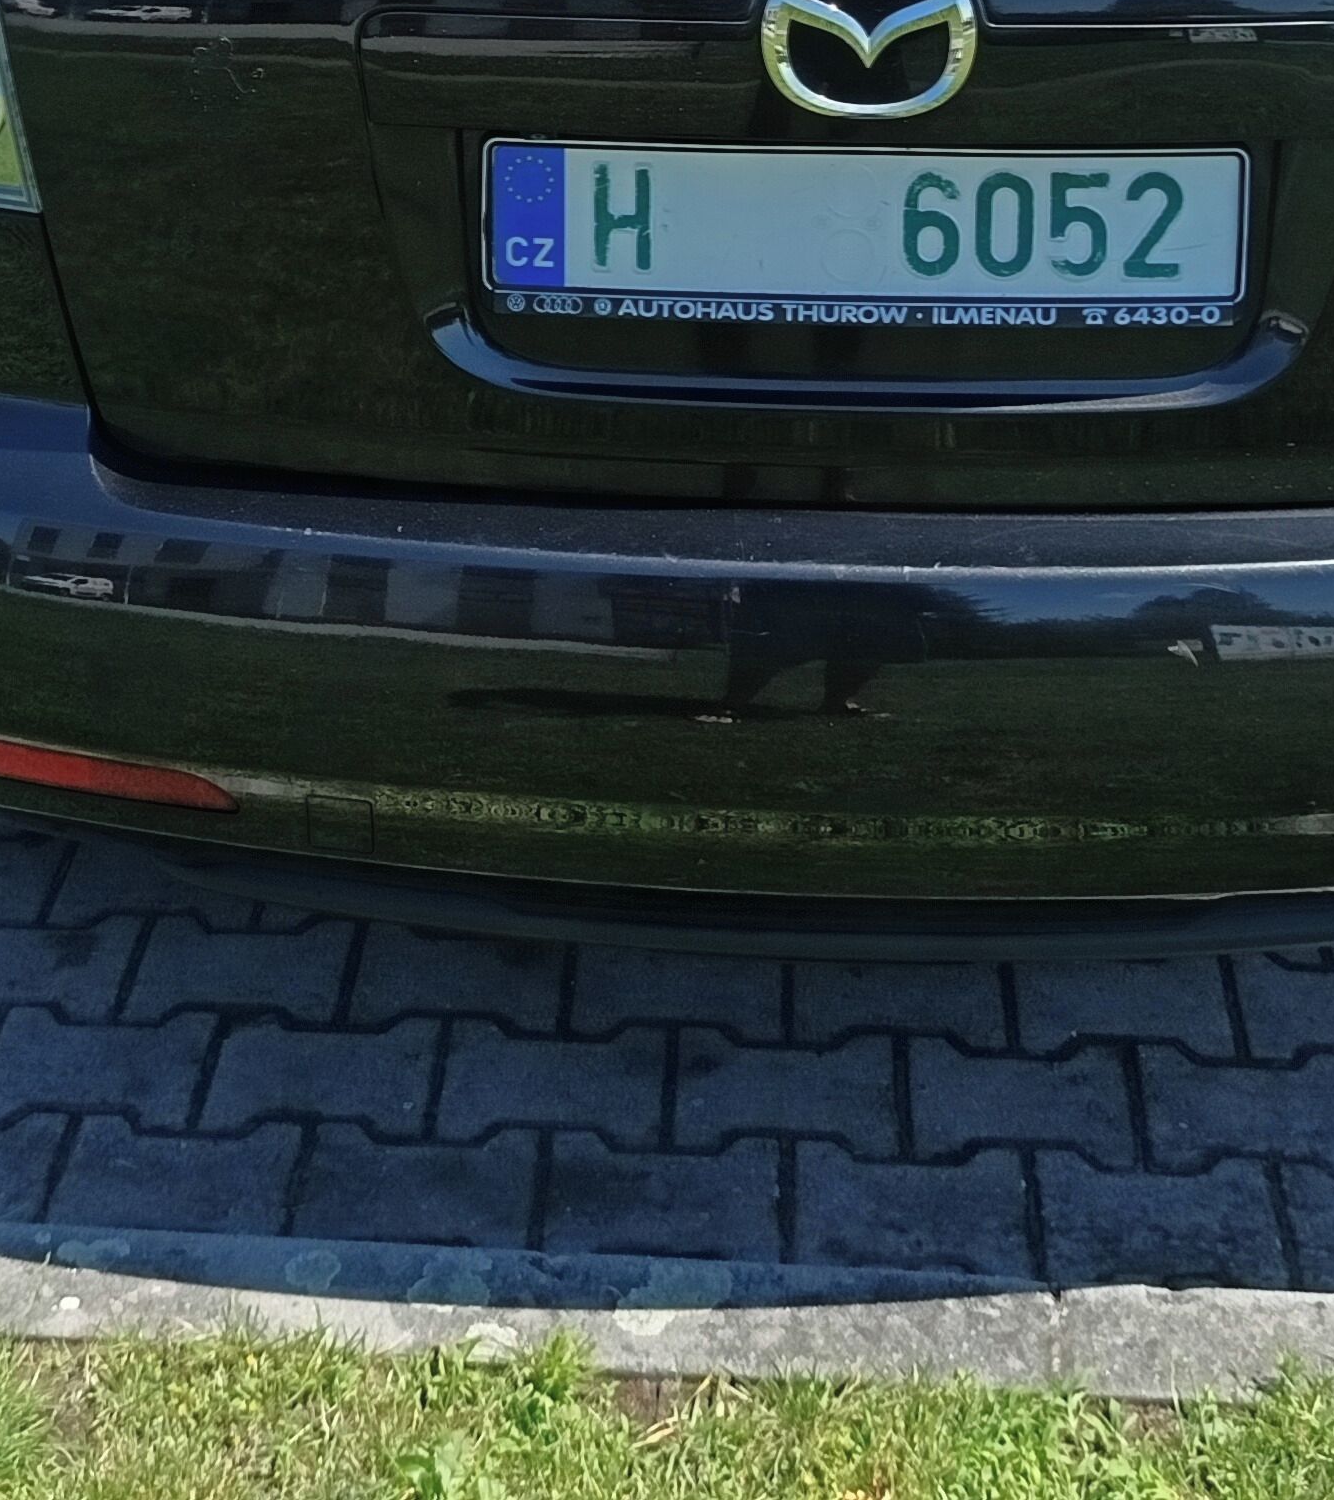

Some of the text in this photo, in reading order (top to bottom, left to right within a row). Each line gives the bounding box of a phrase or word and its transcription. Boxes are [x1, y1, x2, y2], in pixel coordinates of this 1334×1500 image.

[593, 162, 1184, 278] H 6052
[505, 235, 555, 268] CZ
[618, 298, 1221, 326] AUTOHAUS THUROW ILMENAU 6430-0
